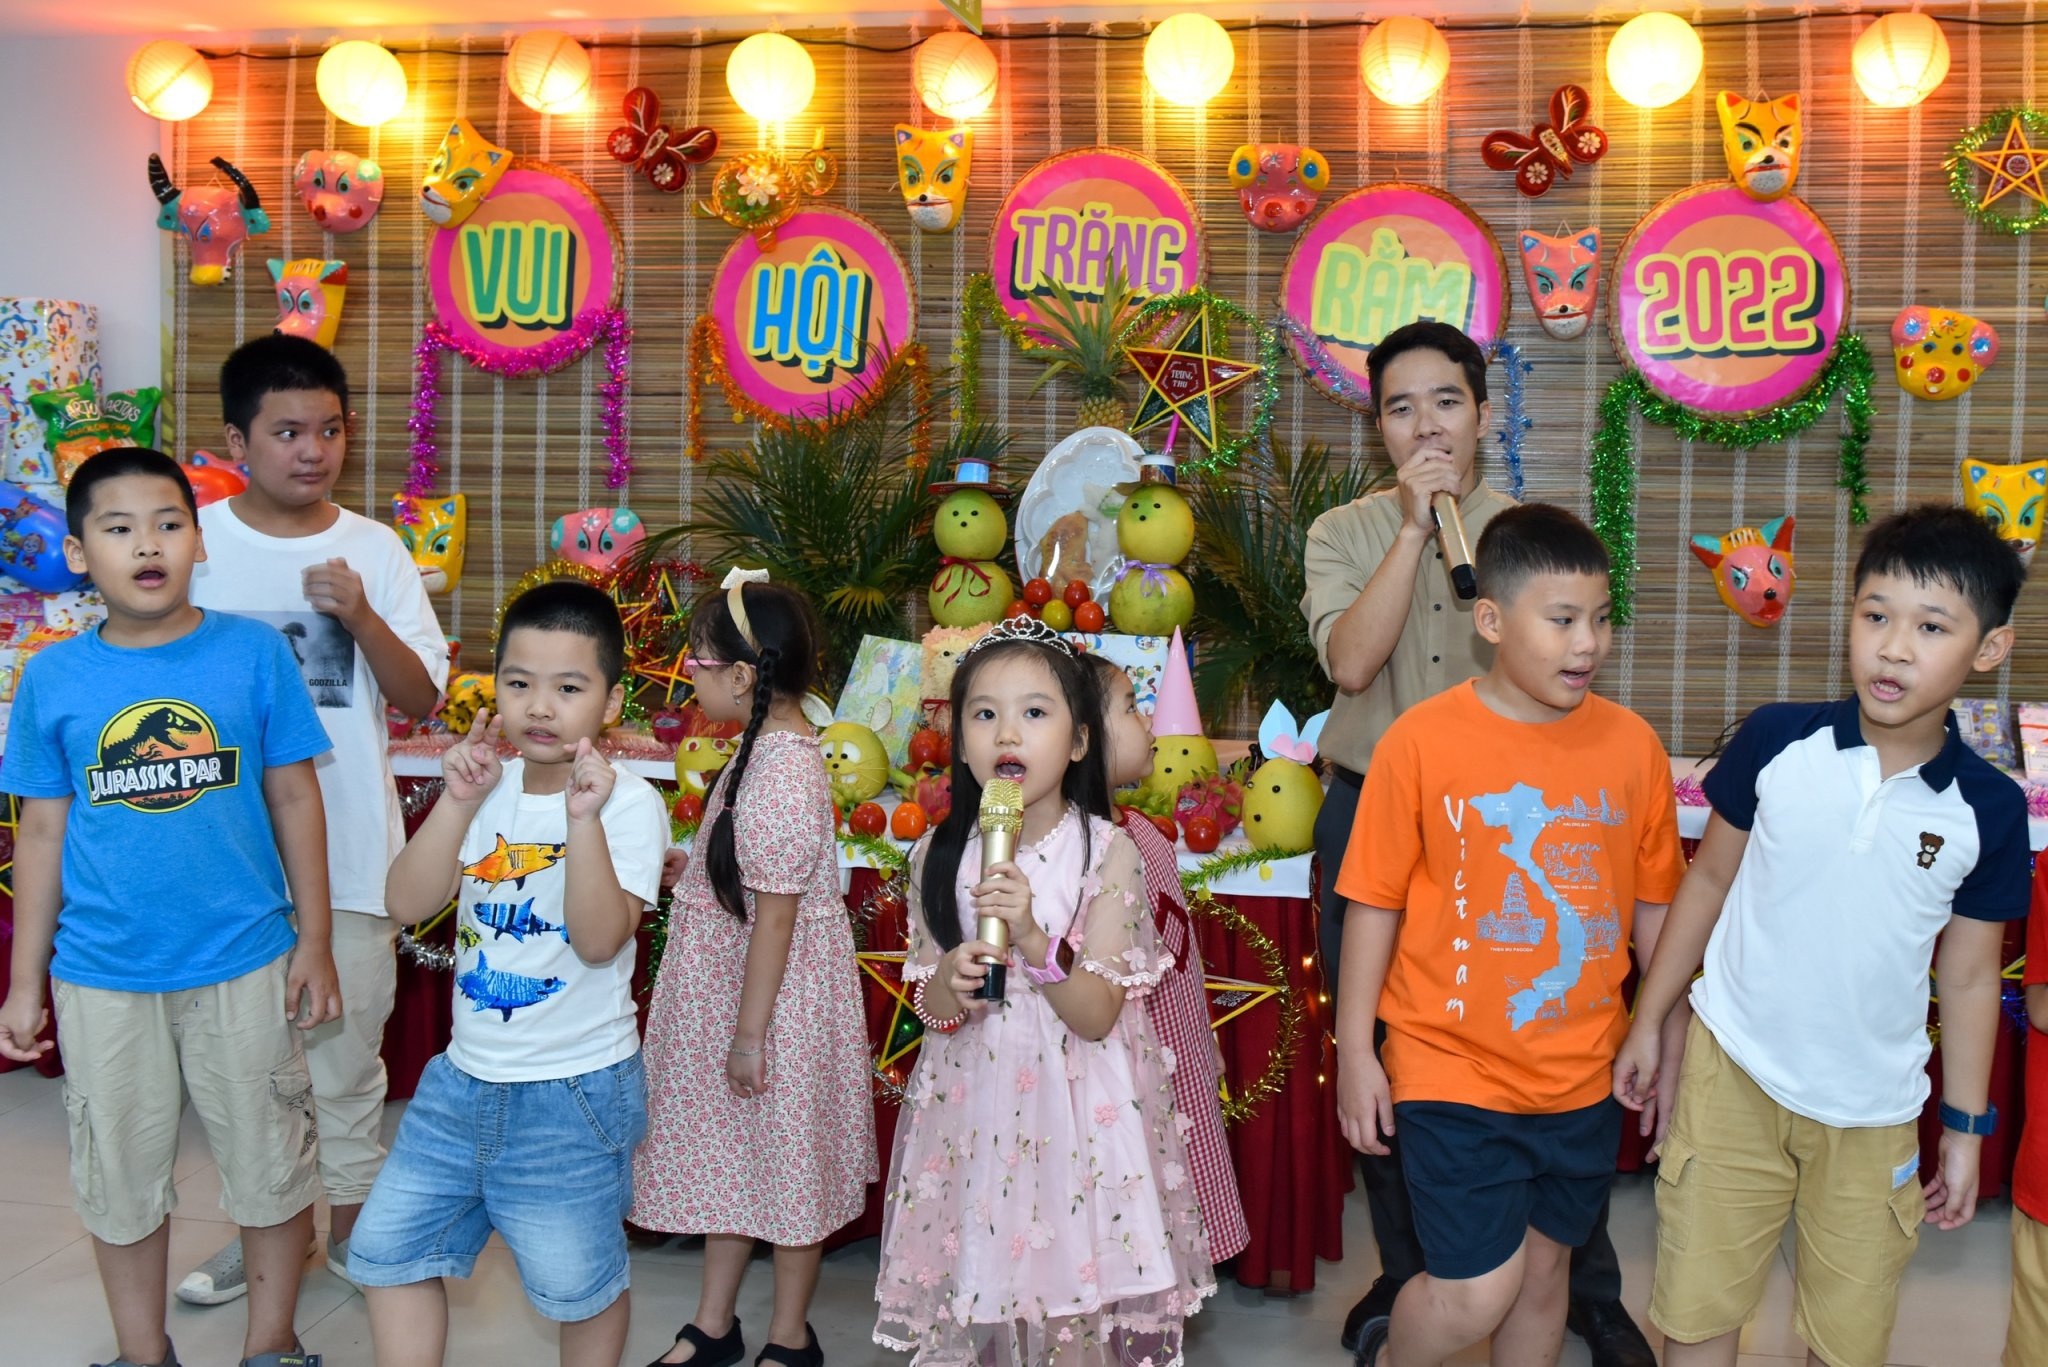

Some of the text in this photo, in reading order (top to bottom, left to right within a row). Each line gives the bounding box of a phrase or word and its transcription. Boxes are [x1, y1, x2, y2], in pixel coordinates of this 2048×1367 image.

[460, 219, 570, 324] VUI
[1011, 202, 1187, 299] TRĂNG
[1311, 228, 1472, 344] RẰM
[1635, 247, 1817, 355] 2022
[747, 242, 866, 378] HỘI
[308, 678, 348, 687] GODZILLA
[91, 757, 223, 801] JURASSIC PAR
